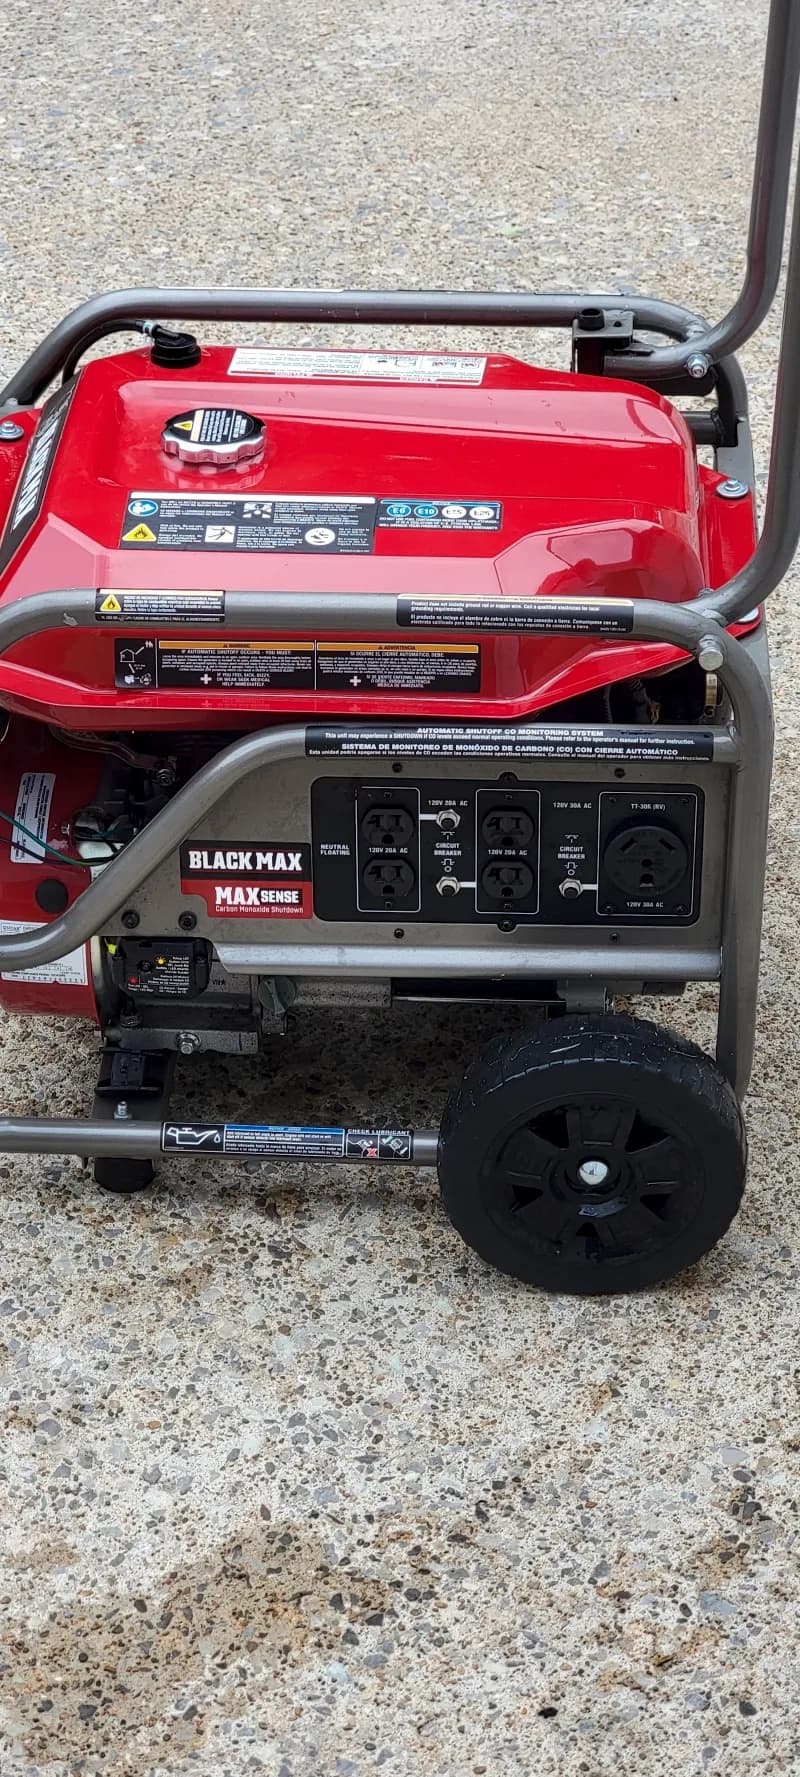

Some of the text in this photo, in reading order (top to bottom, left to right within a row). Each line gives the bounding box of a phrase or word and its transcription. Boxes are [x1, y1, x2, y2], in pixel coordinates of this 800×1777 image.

[626, 747, 678, 755] AUTOMÁTICO
[189, 851, 302, 871] BLACK MAX
